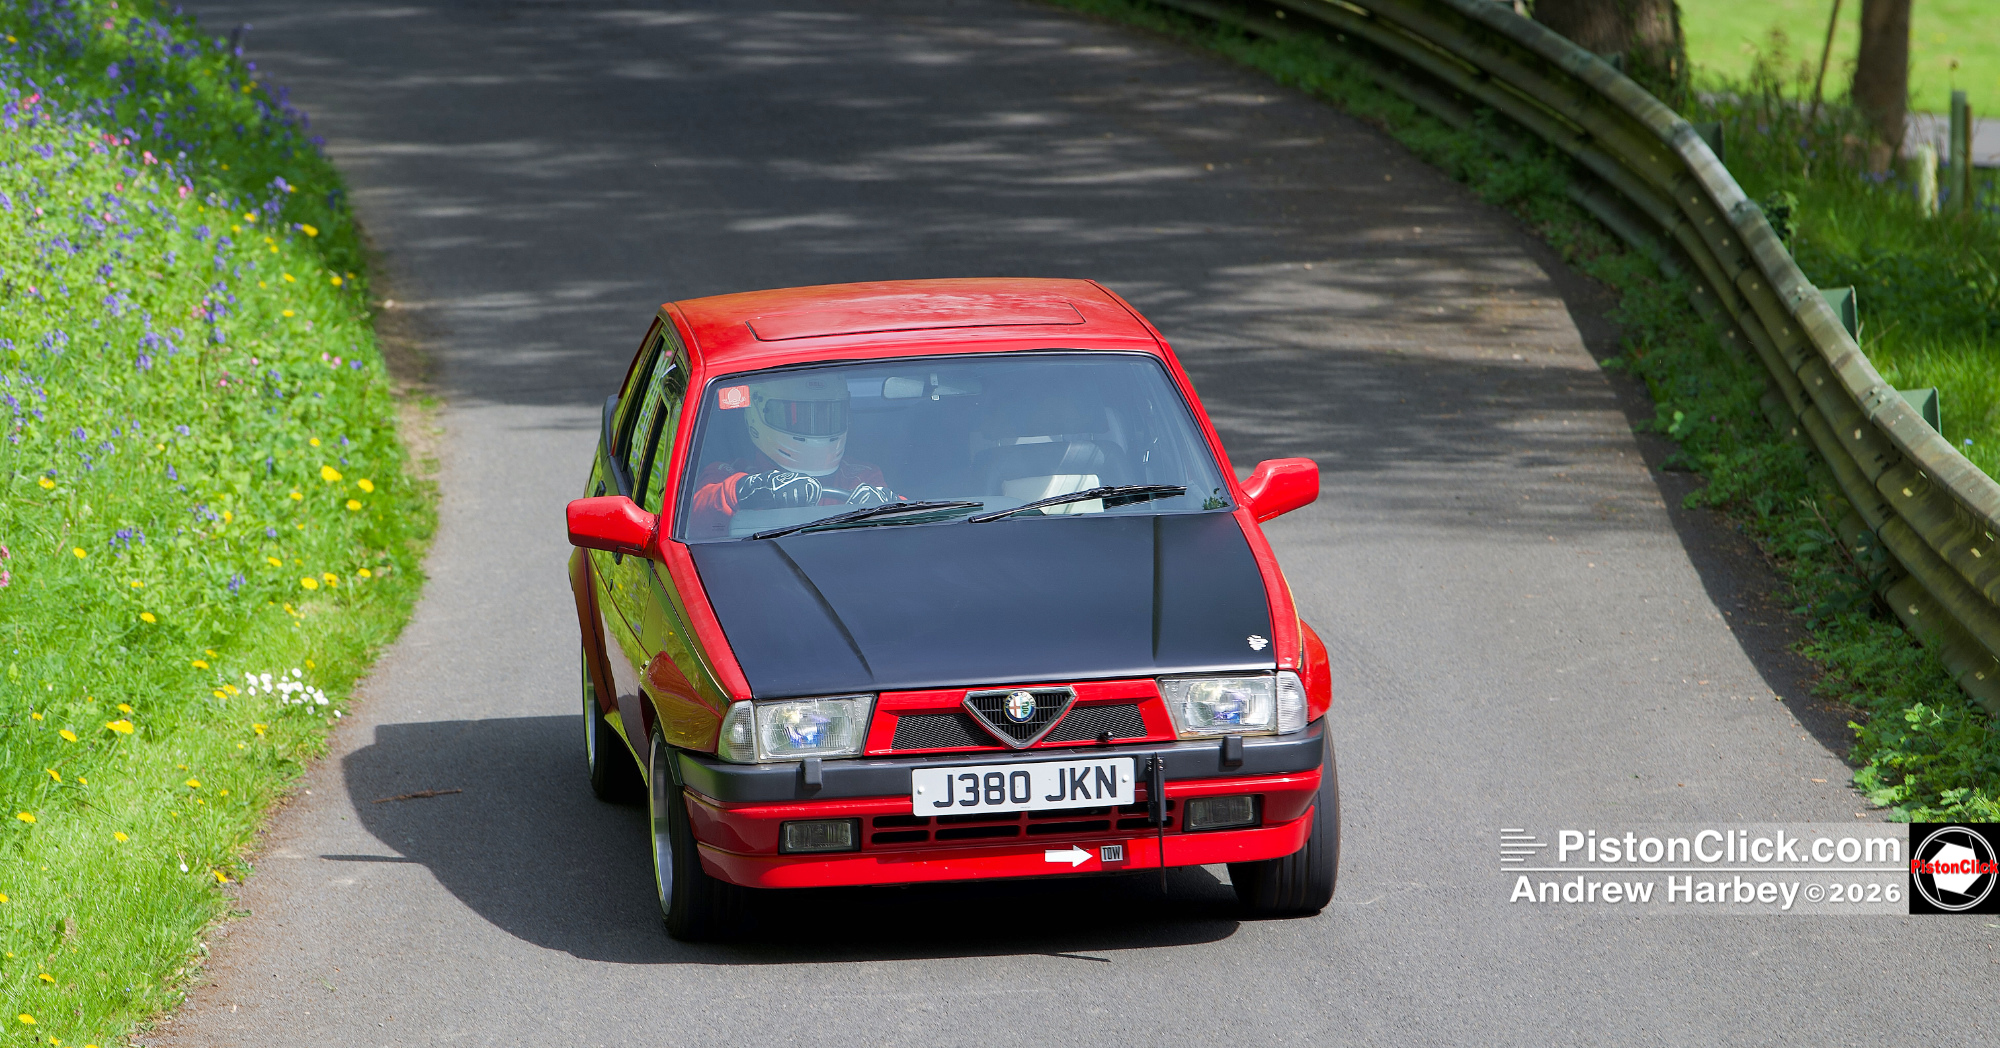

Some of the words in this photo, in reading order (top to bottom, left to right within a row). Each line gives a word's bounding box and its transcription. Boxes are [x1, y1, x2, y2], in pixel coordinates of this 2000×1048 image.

[932, 770, 1031, 808] J380
[1044, 764, 1117, 802] JKN
[1102, 846, 1121, 860] TOW
